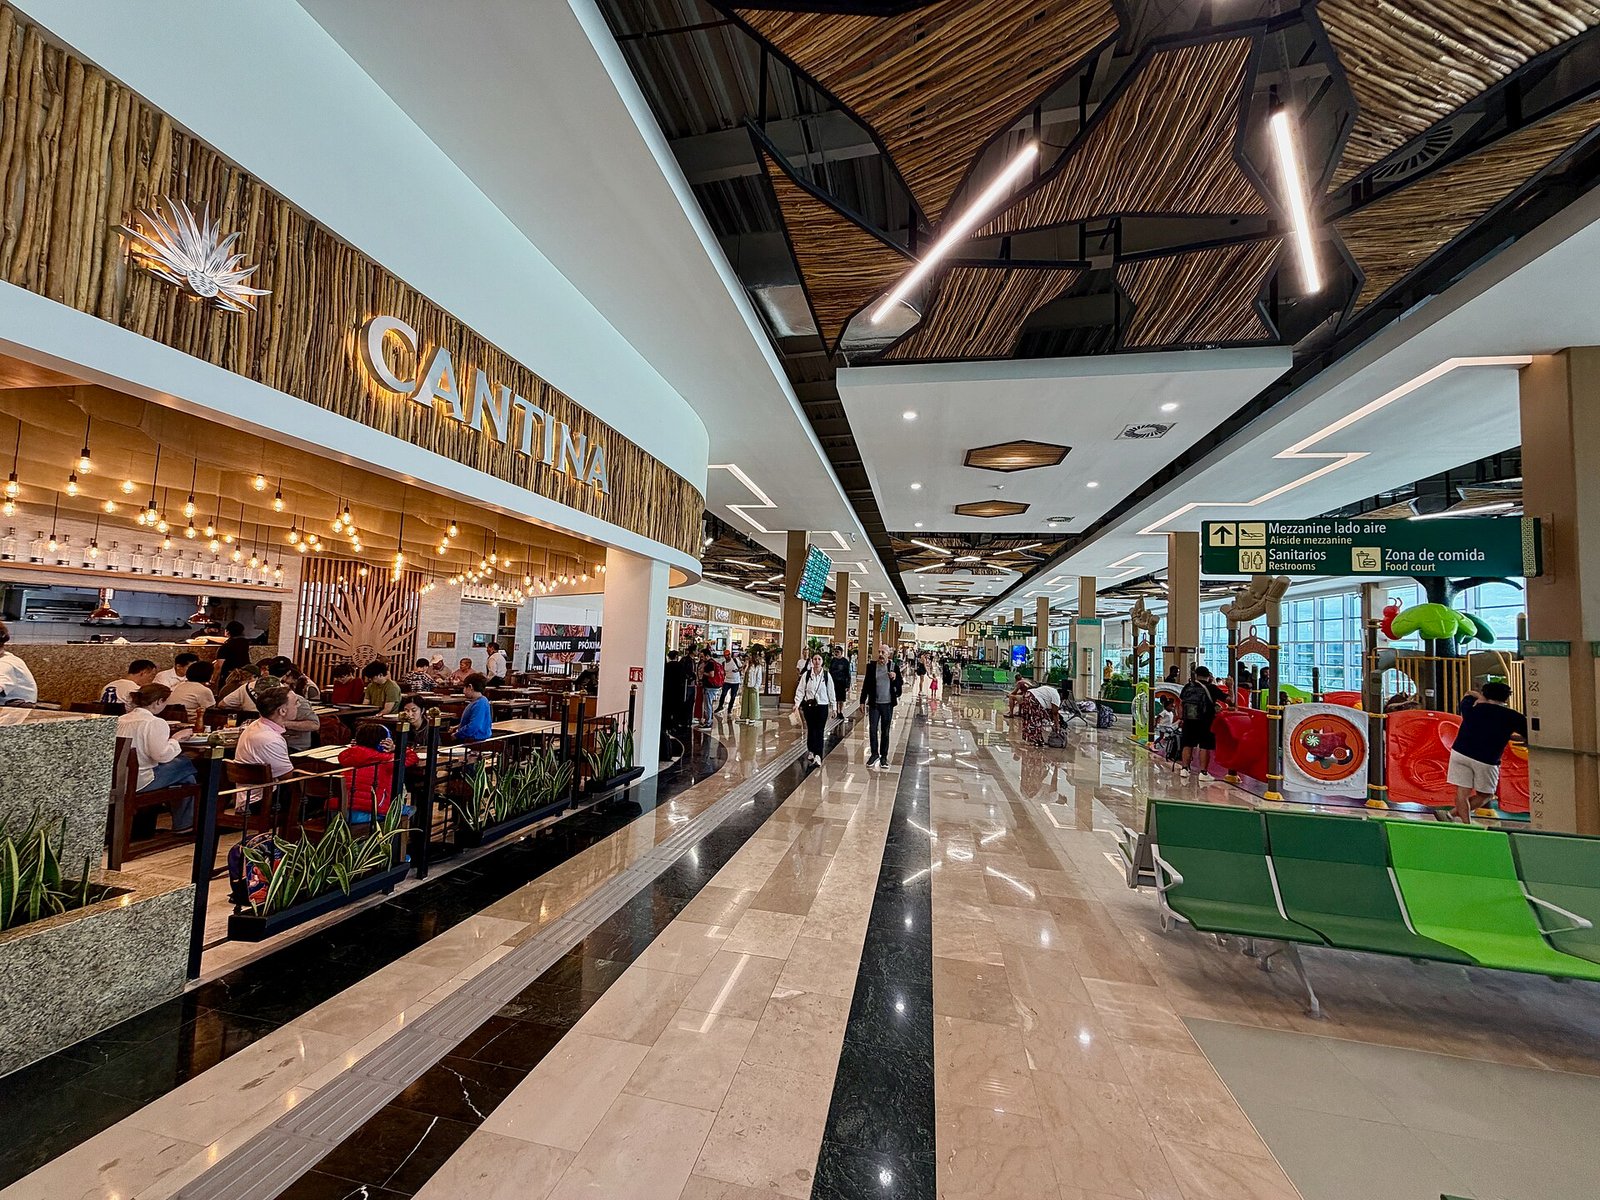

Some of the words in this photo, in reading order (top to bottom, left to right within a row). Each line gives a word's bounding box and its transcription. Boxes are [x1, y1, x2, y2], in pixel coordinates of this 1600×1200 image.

[360, 315, 609, 495] CANTINA
[1268, 523, 1331, 534] Mezzanine
[1335, 522, 1360, 534] lado
[1364, 522, 1386, 534] aire
[1270, 536, 1301, 544] Airside
[1303, 536, 1352, 544] mezzanine
[1269, 549, 1326, 560] Sanitarios
[1385, 548, 1415, 560] Zona
[1419, 548, 1434, 560] de
[1438, 548, 1485, 560] comida
[1269, 562, 1316, 570] Restrooms
[1385, 562, 1408, 571] Food
[1411, 563, 1435, 571] court
